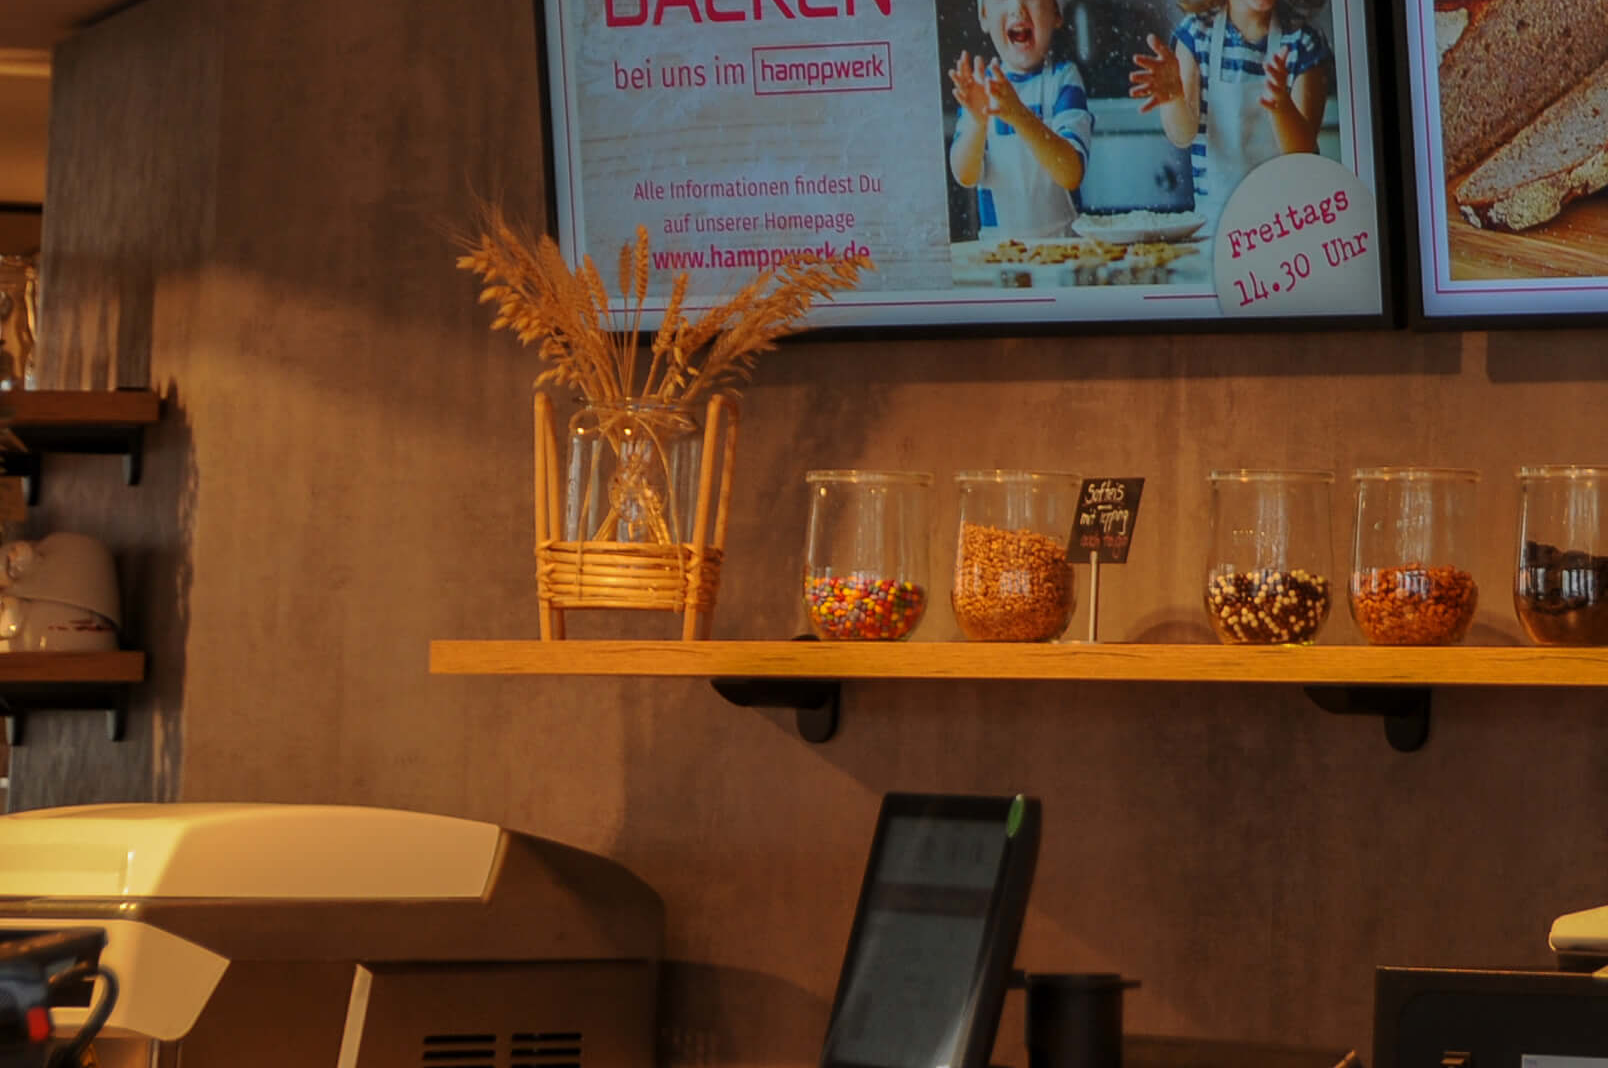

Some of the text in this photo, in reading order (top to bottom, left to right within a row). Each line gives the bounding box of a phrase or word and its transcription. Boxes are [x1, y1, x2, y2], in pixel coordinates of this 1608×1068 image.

[613, 54, 884, 90] bei uns im hamppwerk
[633, 174, 882, 201] Alle Informationen findest Du
[663, 211, 855, 233] auf unserer Homepage
[1227, 190, 1349, 259] Freitags
[1233, 231, 1369, 307] 14.30 Uhr
